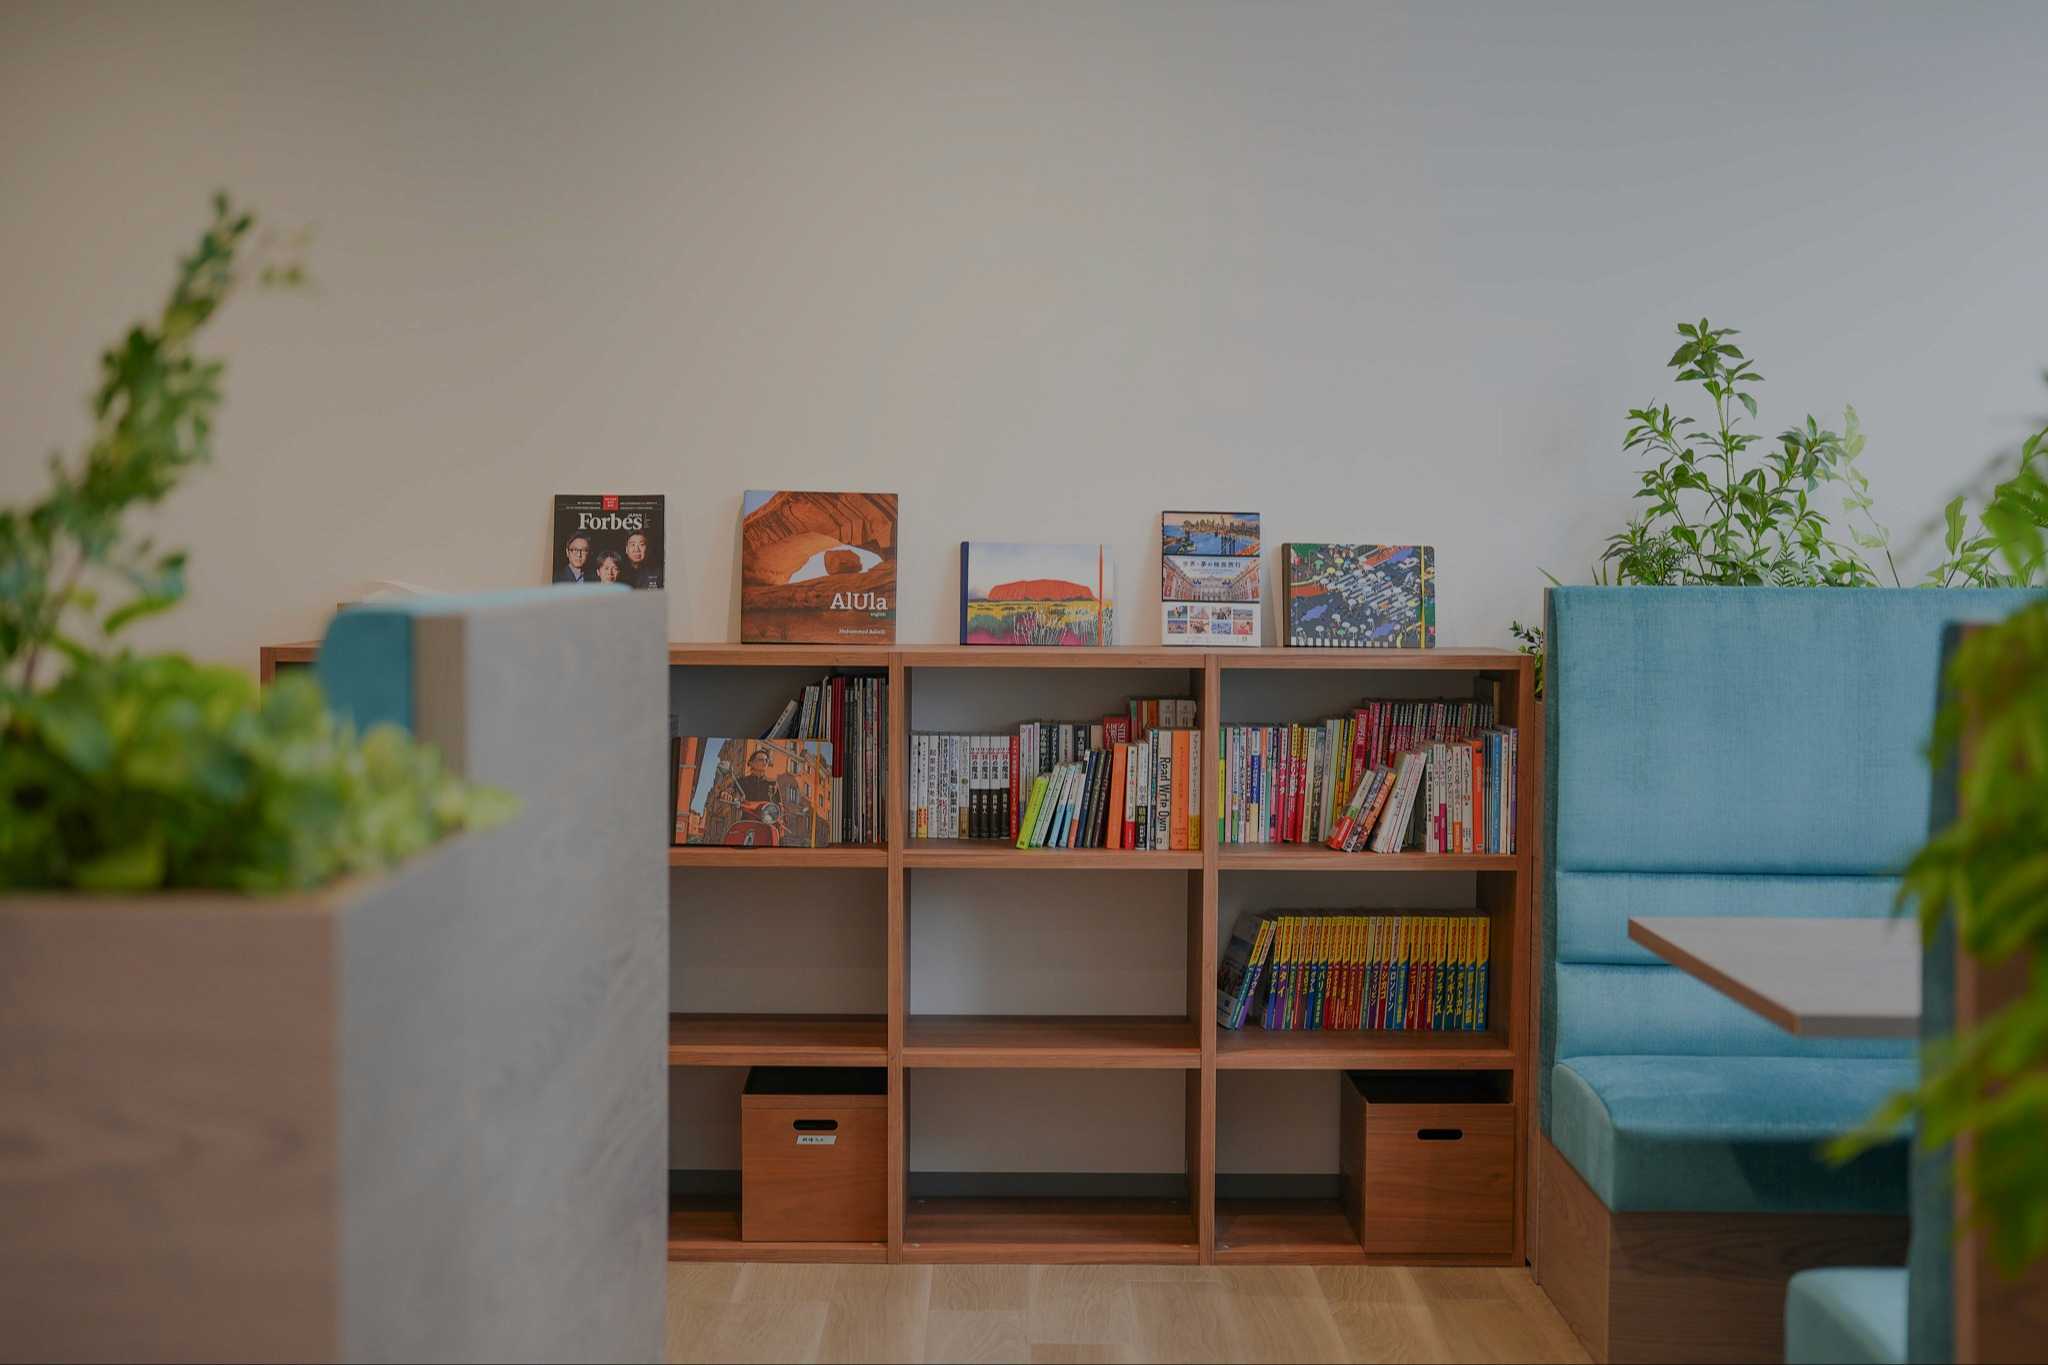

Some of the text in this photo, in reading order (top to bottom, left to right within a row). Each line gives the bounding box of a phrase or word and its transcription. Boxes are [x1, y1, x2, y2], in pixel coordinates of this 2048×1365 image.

[578, 512, 643, 530] Forbes
[830, 592, 888, 610] AlUla
[1160, 757, 1171, 781] Read
[1159, 811, 1170, 832] Own
